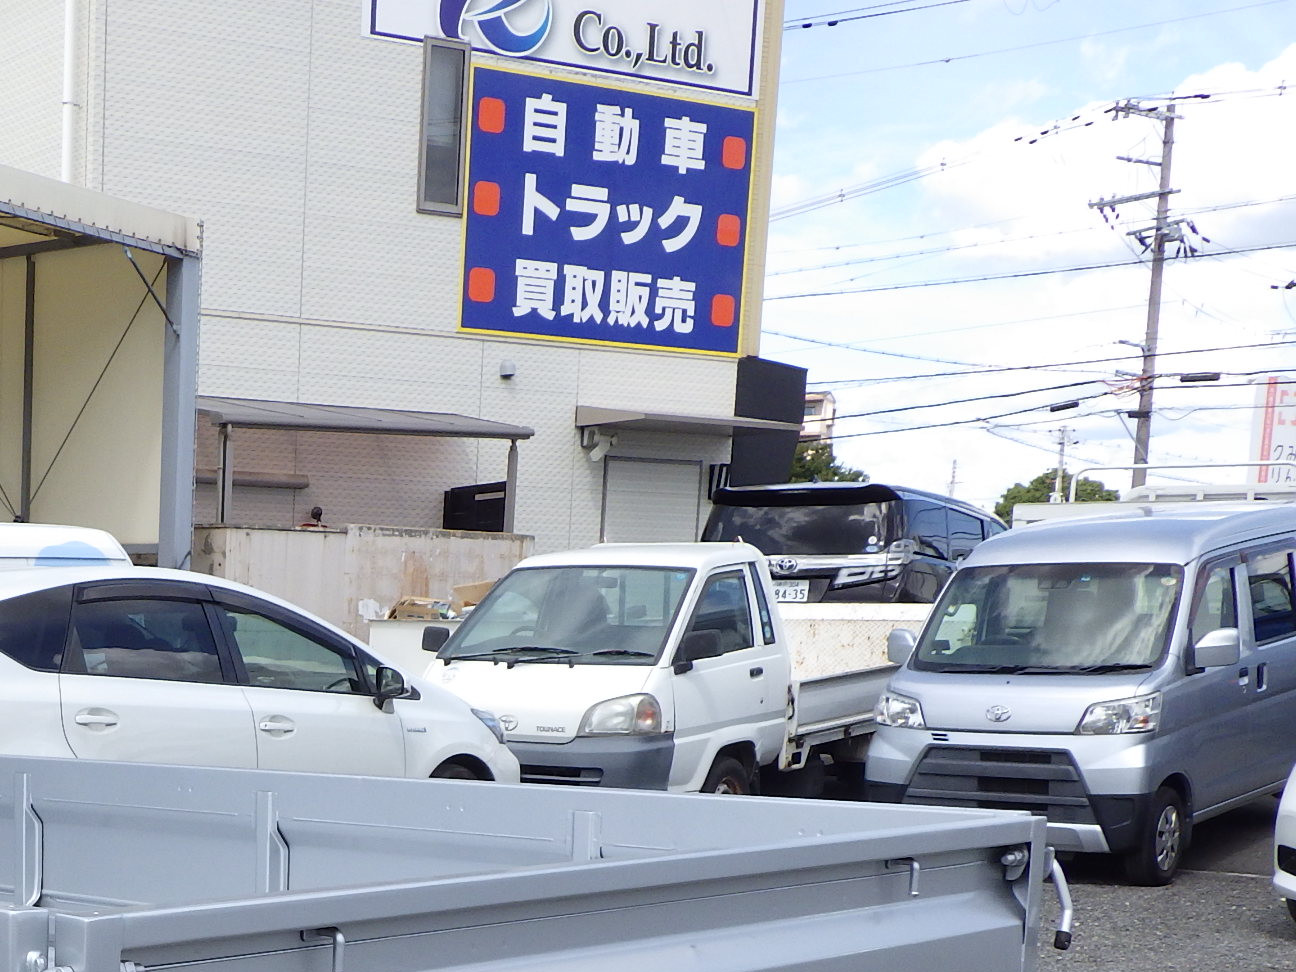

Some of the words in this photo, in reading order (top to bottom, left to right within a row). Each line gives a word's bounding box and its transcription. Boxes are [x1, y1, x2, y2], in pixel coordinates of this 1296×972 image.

[573, 10, 715, 73] Co.,Ltd.
[522, 93, 708, 175] 自動車
[521, 172, 703, 253] トラック
[512, 258, 697, 334] 買取販売
